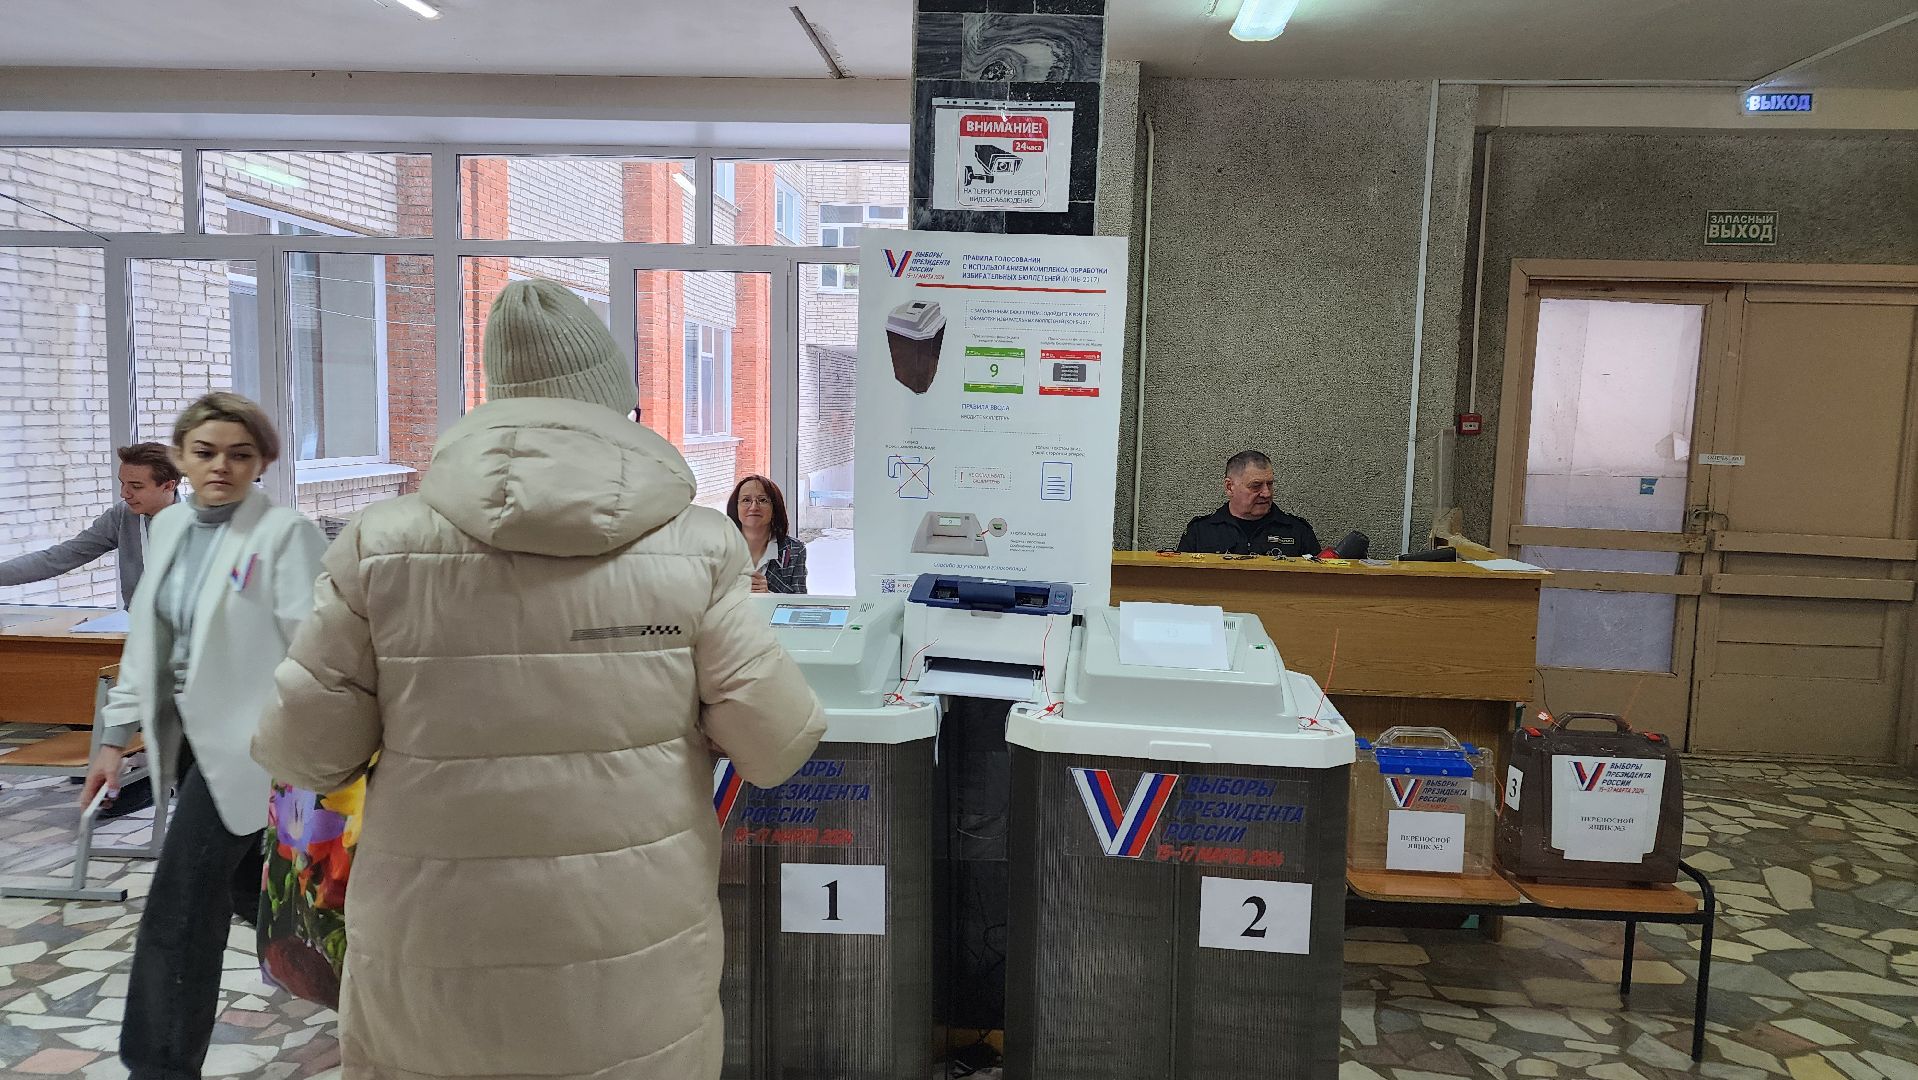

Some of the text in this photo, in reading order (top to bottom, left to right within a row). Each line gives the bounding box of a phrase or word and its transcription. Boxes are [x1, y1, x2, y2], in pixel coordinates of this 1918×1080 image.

[1748, 95, 1811, 111] ВЫХОД
[966, 121, 1043, 135] ВНИМАНИЕ!
[974, 188, 1013, 196] ТЕРРИТОРИИ
[969, 196, 1033, 204] ВИДЕОНАБЛЮДЕНИЕ
[1711, 215, 1773, 223] ЗАПАСНЫЙ
[1709, 224, 1773, 241] ВЫХОД
[915, 251, 943, 259] ВЫБОРЫ
[912, 258, 950, 266] ПРЕЗИДЕНТА
[968, 264, 1029, 272] ИСПОЛЬЗОВАНИЕМ
[962, 273, 1017, 281] ИЗБИРАТЕЛЬНЫХ
[1018, 274, 1061, 282] БЮЛЛЕТЕНЕЙ
[990, 363, 999, 378] 9
[1606, 771, 1652, 779] ПРЕЗИДЕНТА
[1185, 776, 1278, 798] ВЫБОРЫ
[1426, 779, 1458, 787] ВЫБОРЫ
[1509, 780, 1518, 797] 3
[748, 783, 871, 803] ПРЕЗИДЕНТА
[1422, 788, 1467, 796] ПРЕЗИДЕНТА
[741, 806, 819, 823] РОССИИ
[1175, 800, 1305, 823] ПРЕЗИДЕНТА
[1581, 816, 1634, 824] ПЕРЕНОСНОЙ
[1163, 823, 1248, 843] РОССИИ
[1400, 835, 1450, 843] ПЕРЕНОСНОЙ
[821, 880, 844, 921] 1
[1240, 896, 1268, 938] 2
